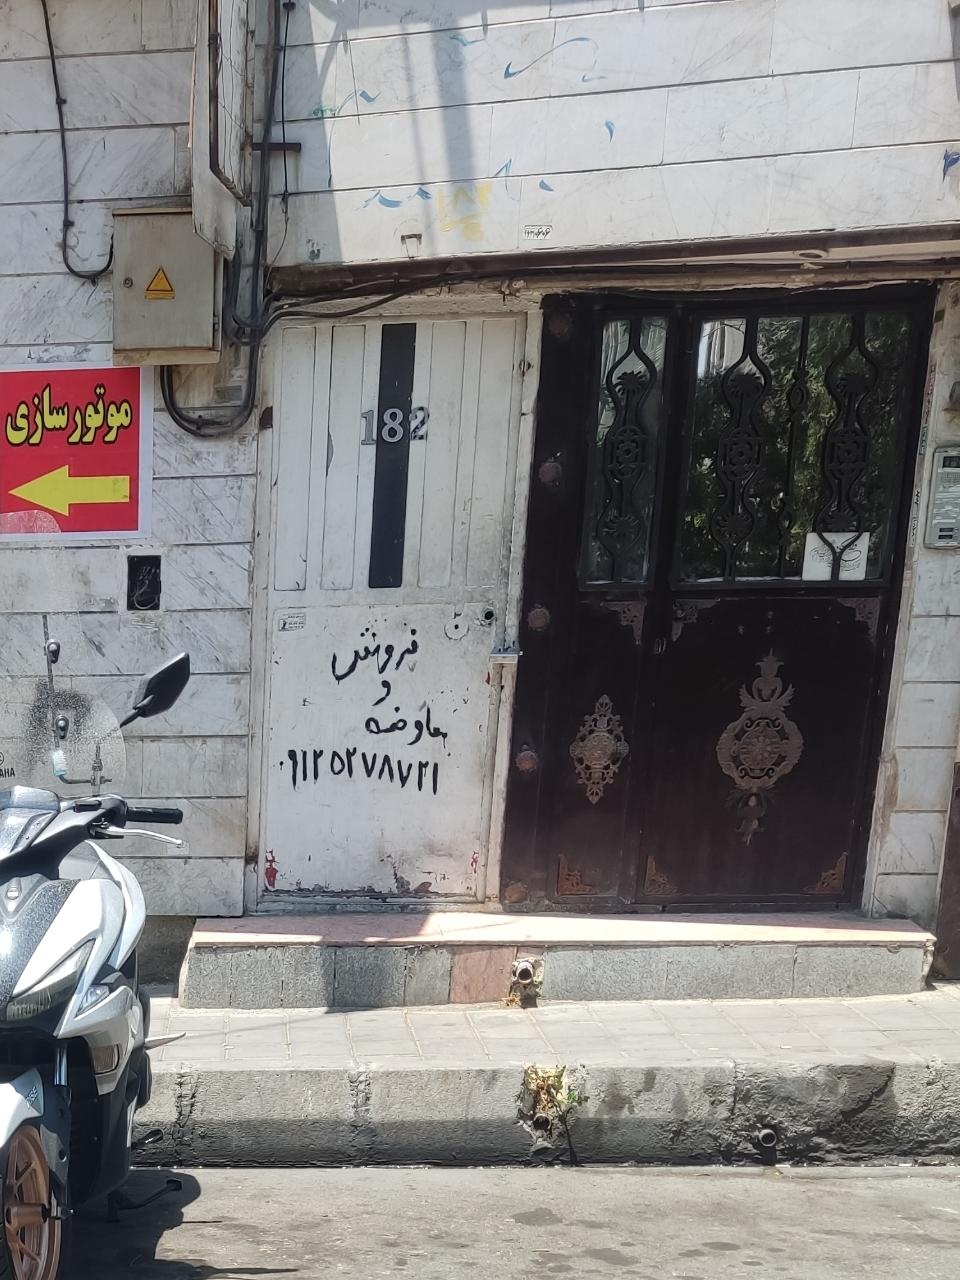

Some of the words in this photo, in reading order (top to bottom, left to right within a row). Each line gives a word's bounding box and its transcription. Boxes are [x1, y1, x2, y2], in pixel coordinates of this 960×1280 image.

[5, 383, 69, 446] سازی
[67, 383, 132, 445] موتور
[360, 406, 430, 445] 182
[331, 628, 419, 683] فروش
[371, 680, 391, 706] و
[365, 706, 448, 746] معاوضه
[279, 747, 439, 795] ۰۹۱۲۵۲۷۸۷۲۱
